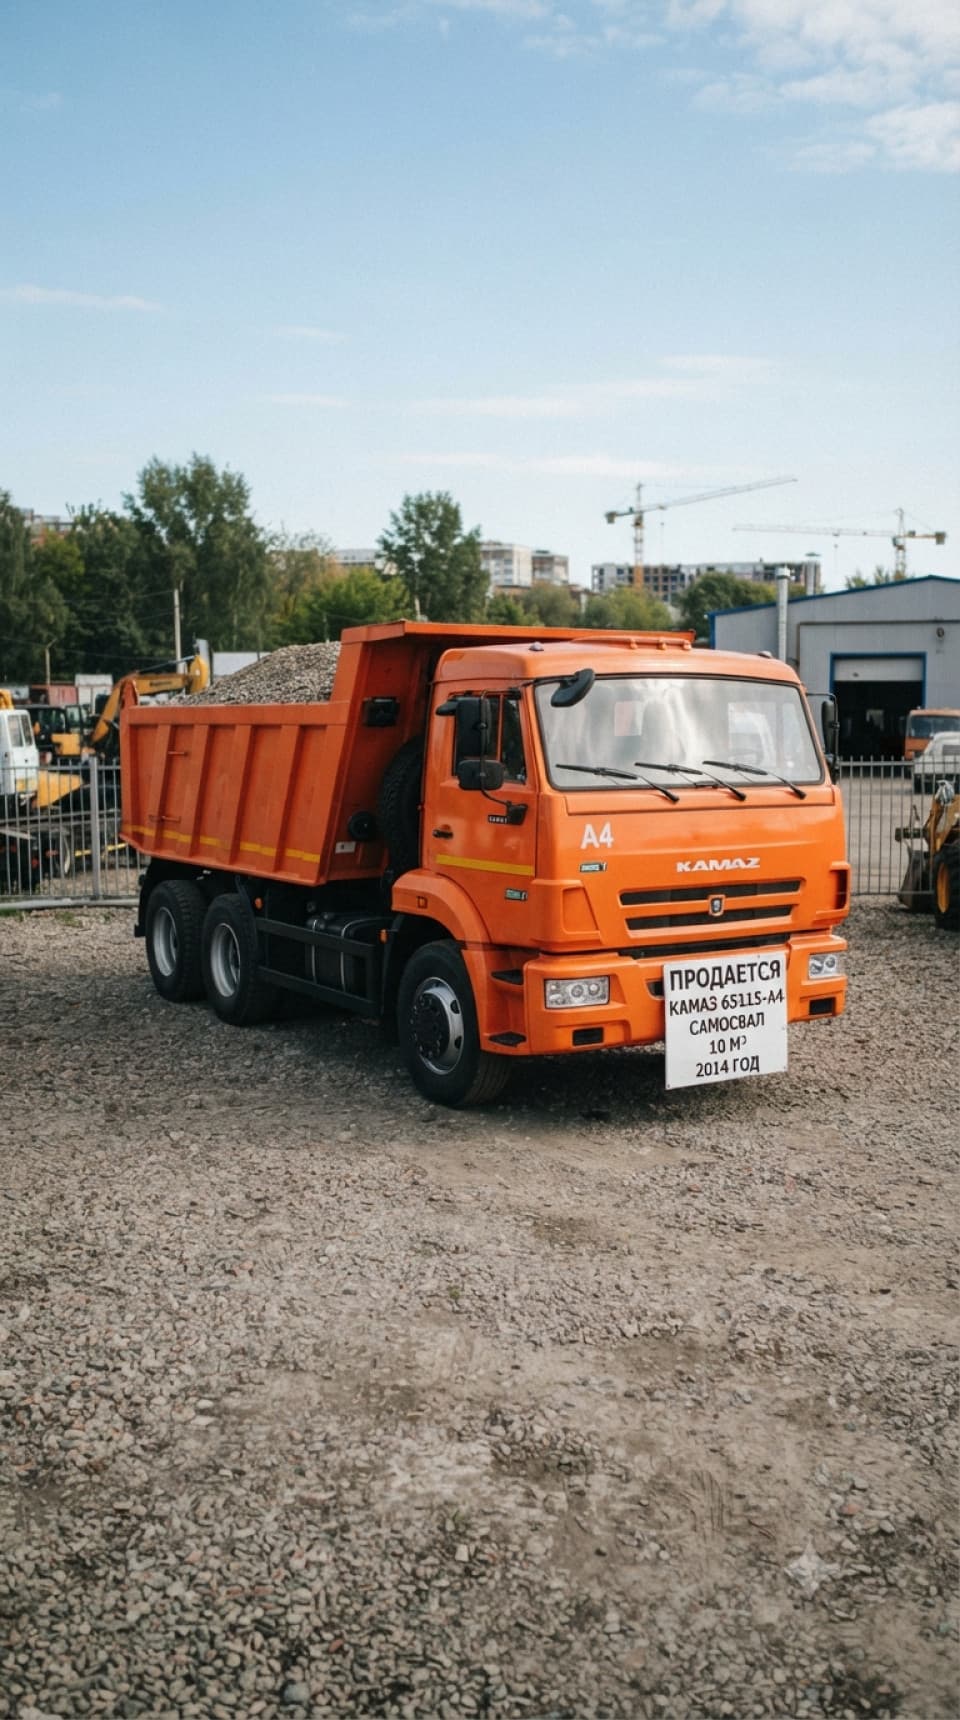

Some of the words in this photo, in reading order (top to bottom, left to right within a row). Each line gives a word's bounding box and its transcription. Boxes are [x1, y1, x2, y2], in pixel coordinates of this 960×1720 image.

[580, 822, 614, 850] A4
[676, 857, 761, 873] KAMAZ
[669, 960, 781, 991] ПРОДАЕТСЯ
[669, 995, 718, 1016] КАМАЗ
[689, 1012, 765, 1036] САМОСВАЛ
[709, 1038, 726, 1055] 10
[695, 1059, 729, 1078] 2014
[733, 1055, 760, 1073] ГОД
